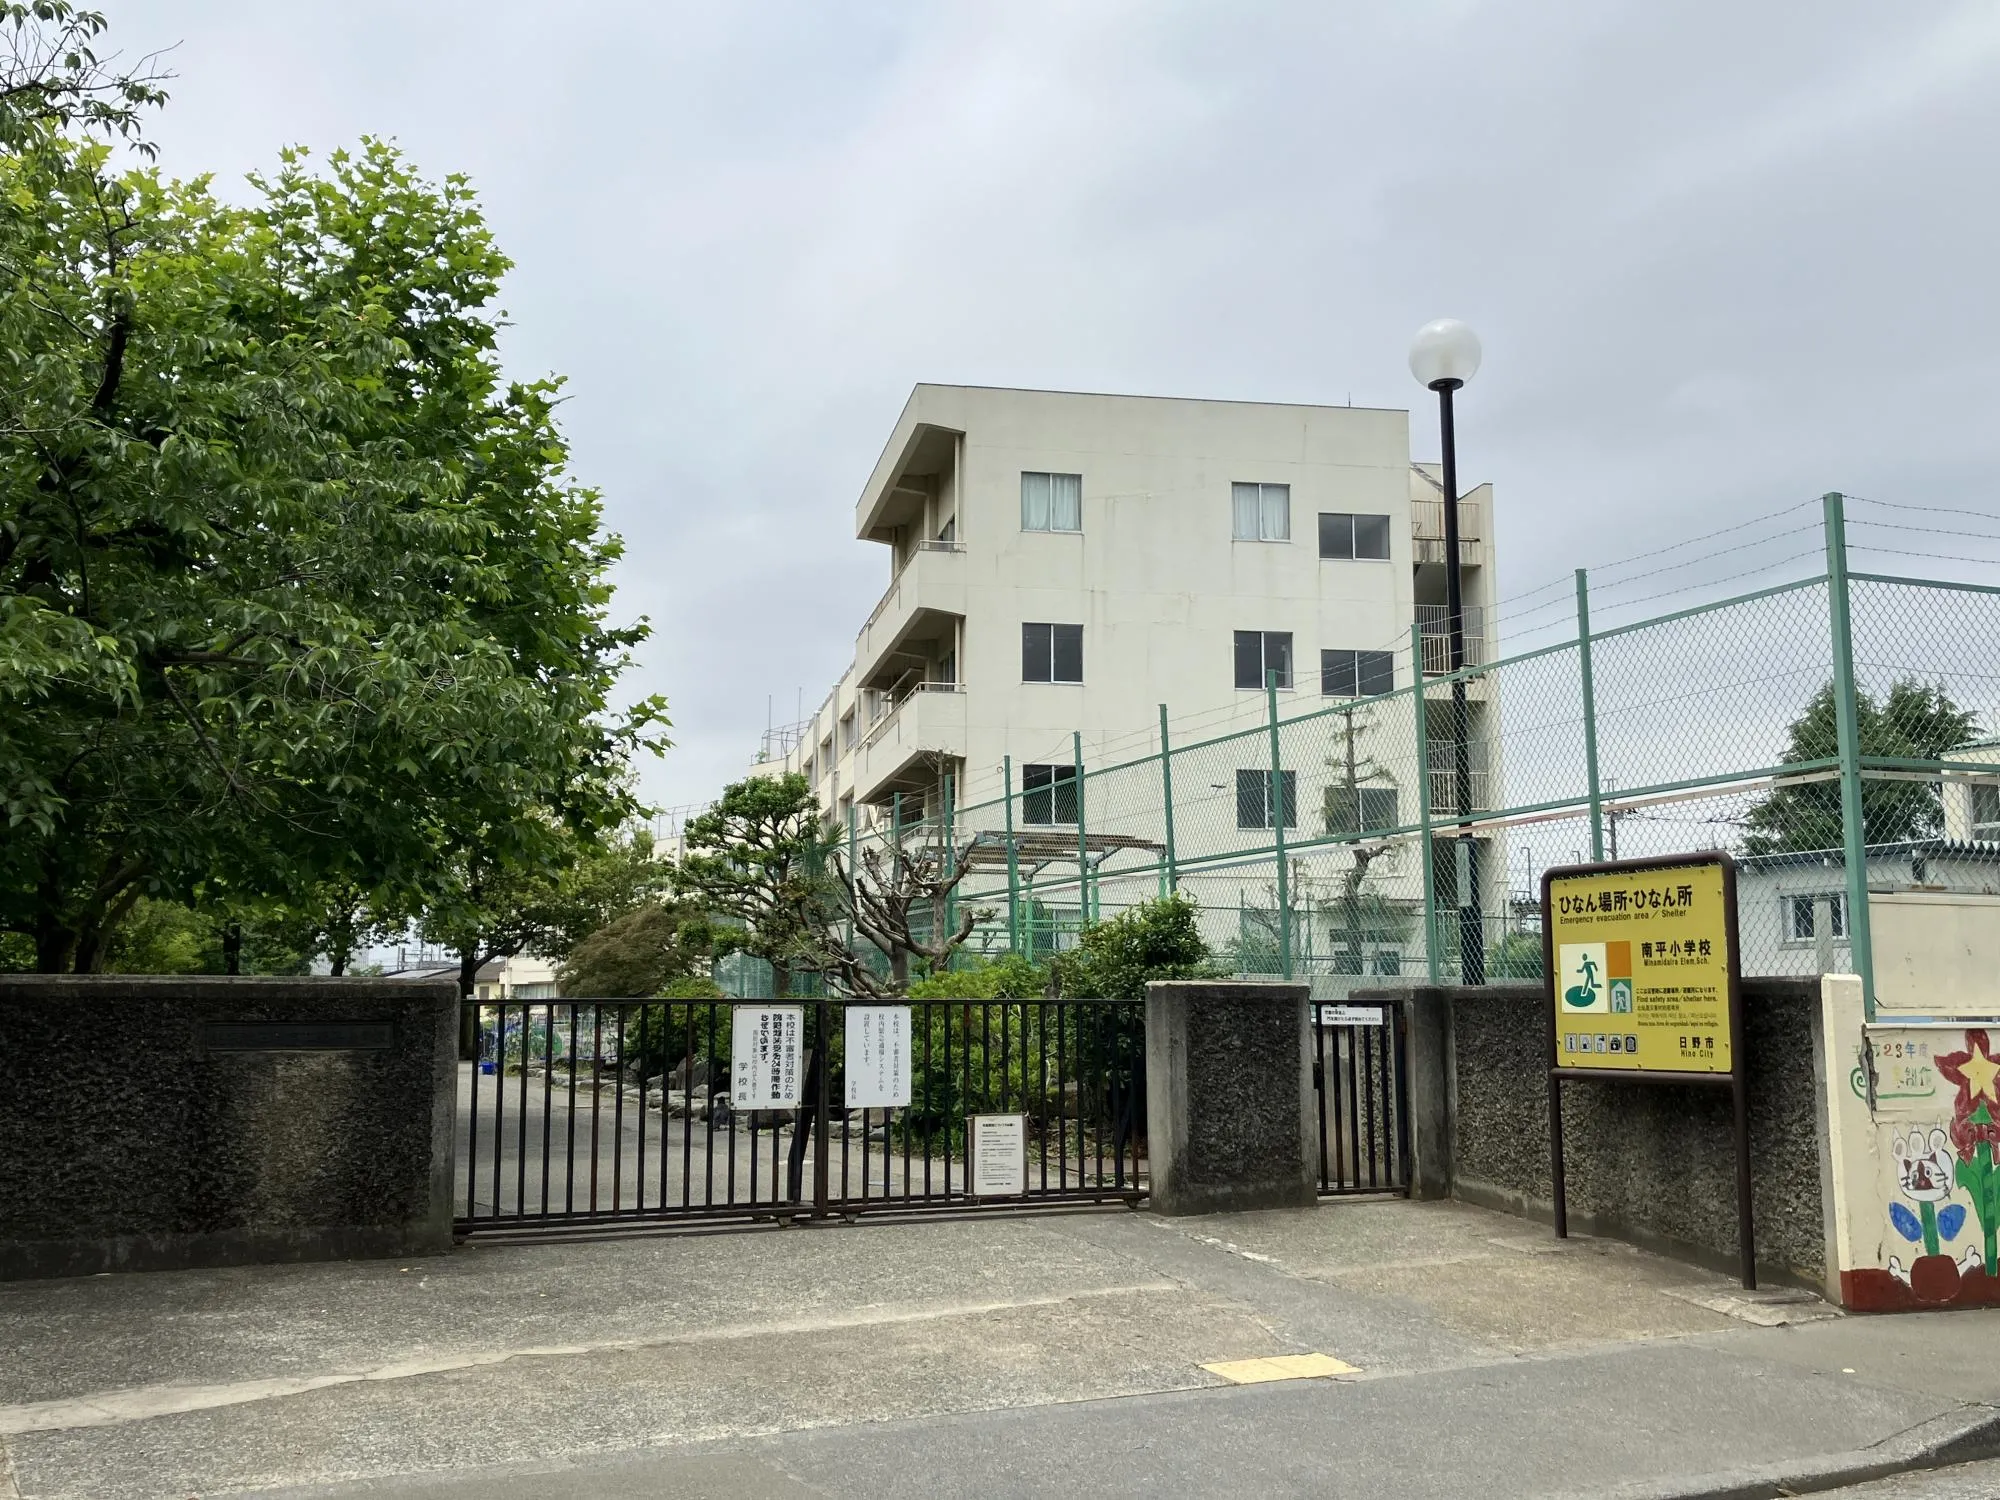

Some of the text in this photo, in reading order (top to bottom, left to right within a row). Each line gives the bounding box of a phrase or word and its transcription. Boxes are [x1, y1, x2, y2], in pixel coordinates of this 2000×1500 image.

[1559, 884, 1693, 915] ひなん場所・ひなん所
[1560, 916, 1593, 925] Emergency
[1596, 912, 1631, 922] evacuation
[1634, 912, 1649, 920] area
[1662, 909, 1687, 918] Shelter
[1641, 938, 1711, 958] 南平小学校
[1644, 958, 1678, 967] Minamidaira
[1679, 1036, 1714, 1049] 日野市
[1681, 1049, 1714, 1058] Hino City
[738, 1062, 748, 1101] 学校長
